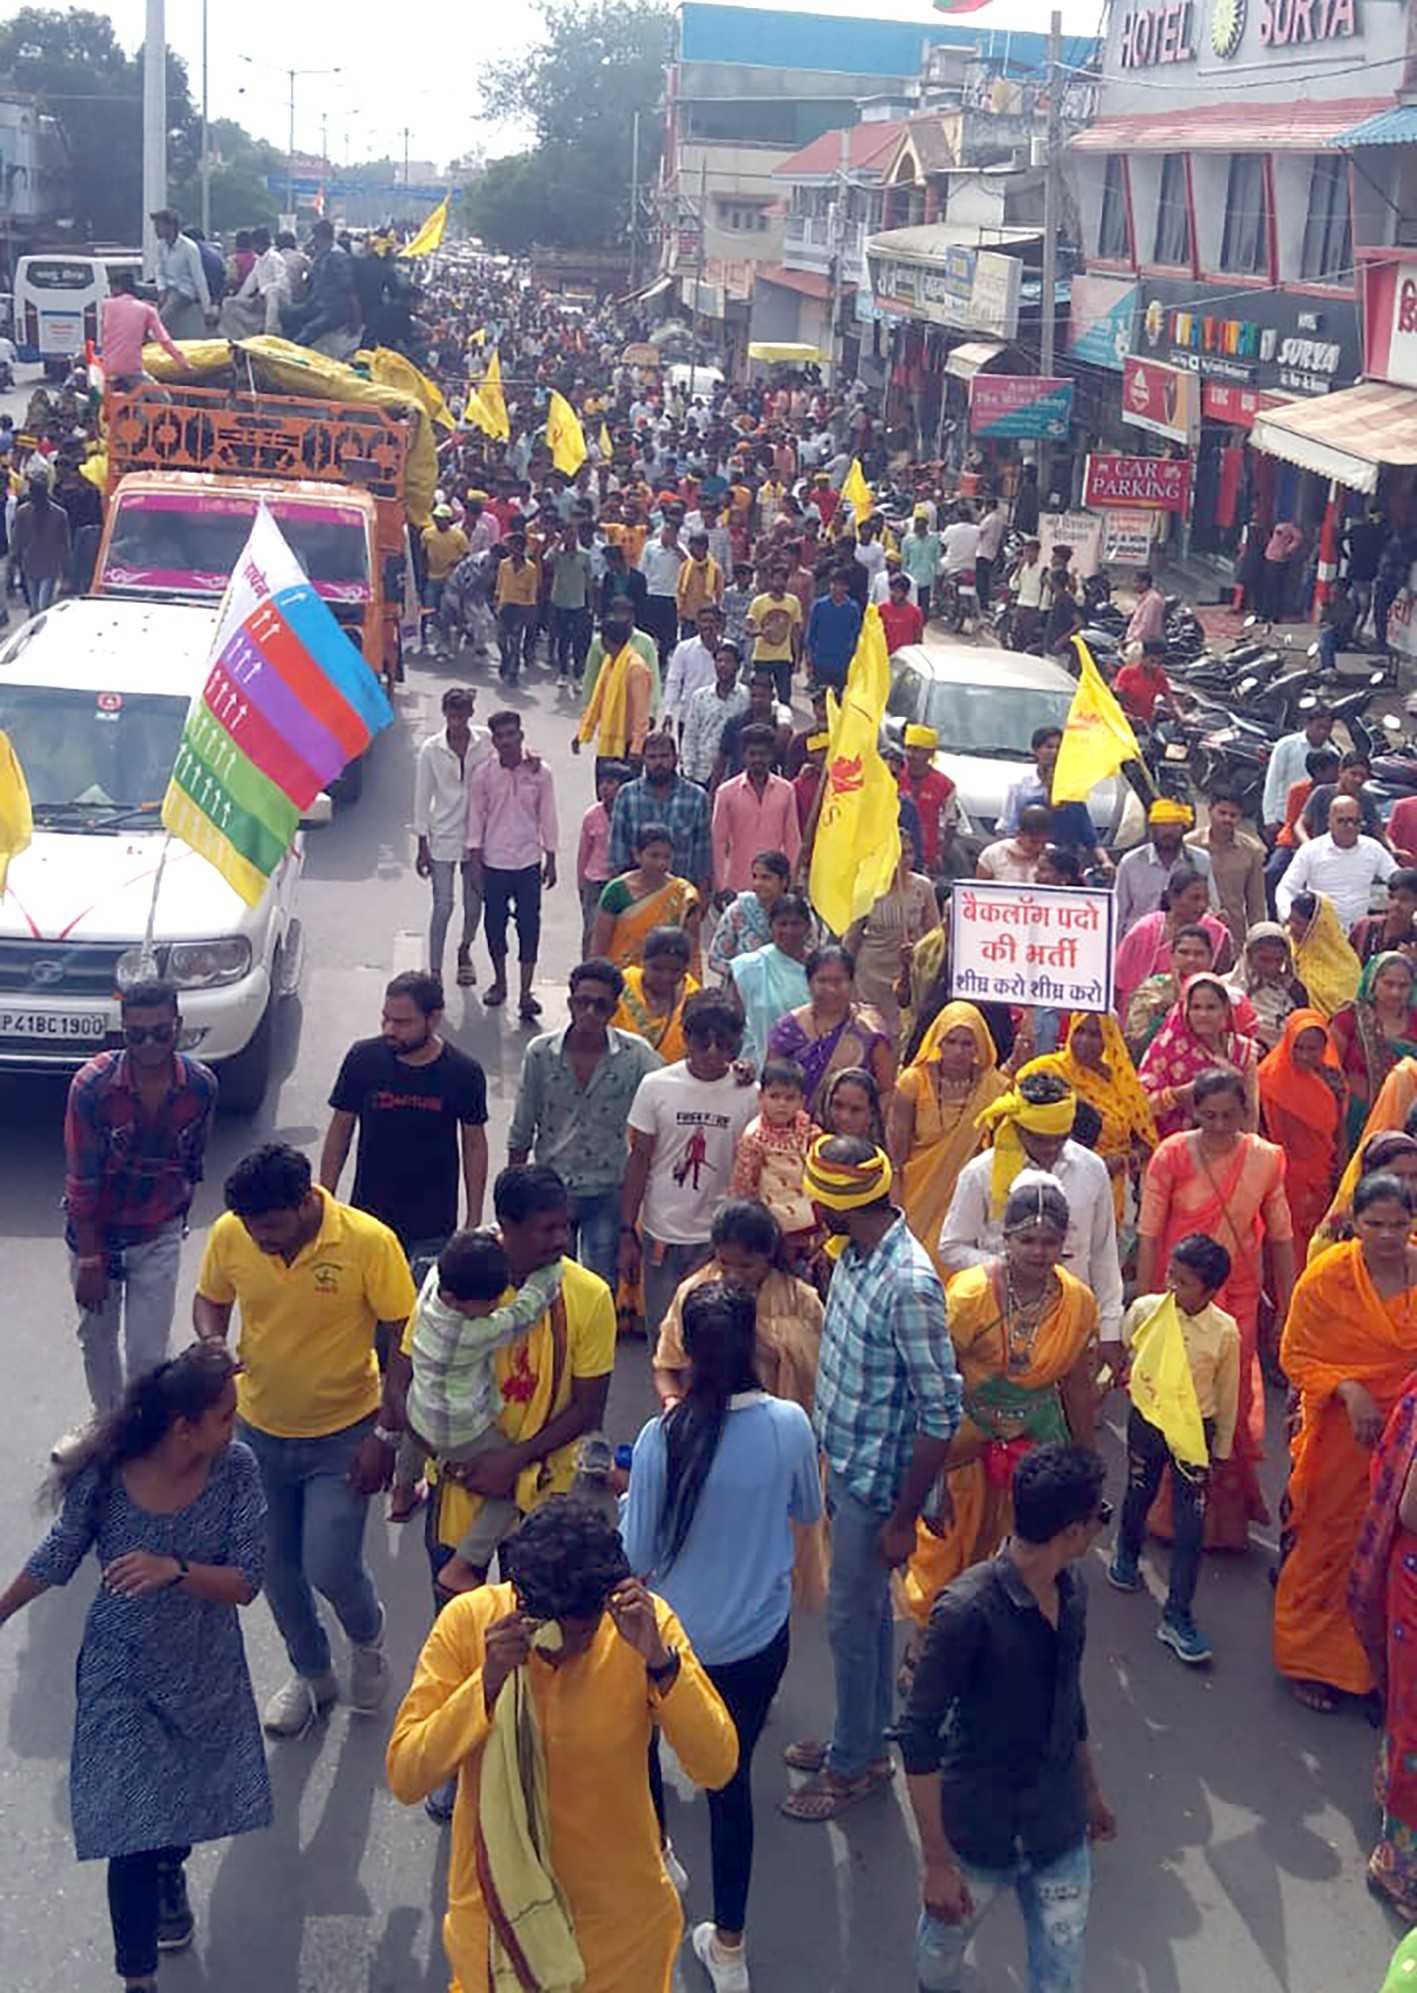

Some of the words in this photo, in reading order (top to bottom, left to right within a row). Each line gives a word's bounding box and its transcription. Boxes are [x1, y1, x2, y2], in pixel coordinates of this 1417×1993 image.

[1121, 3, 1195, 67] HOTEL
[1277, 338, 1339, 372] SURYA
[1115, 461, 1158, 479] CAR
[1091, 478, 1181, 499] PARKING
[1057, 901, 1099, 930] पदो
[980, 933, 1017, 963] की
[1026, 938, 1077, 968] भर्ती
[993, 973, 1025, 996] करो
[1069, 979, 1102, 1003] करो
[3, 1014, 103, 1035] P41BC1900
